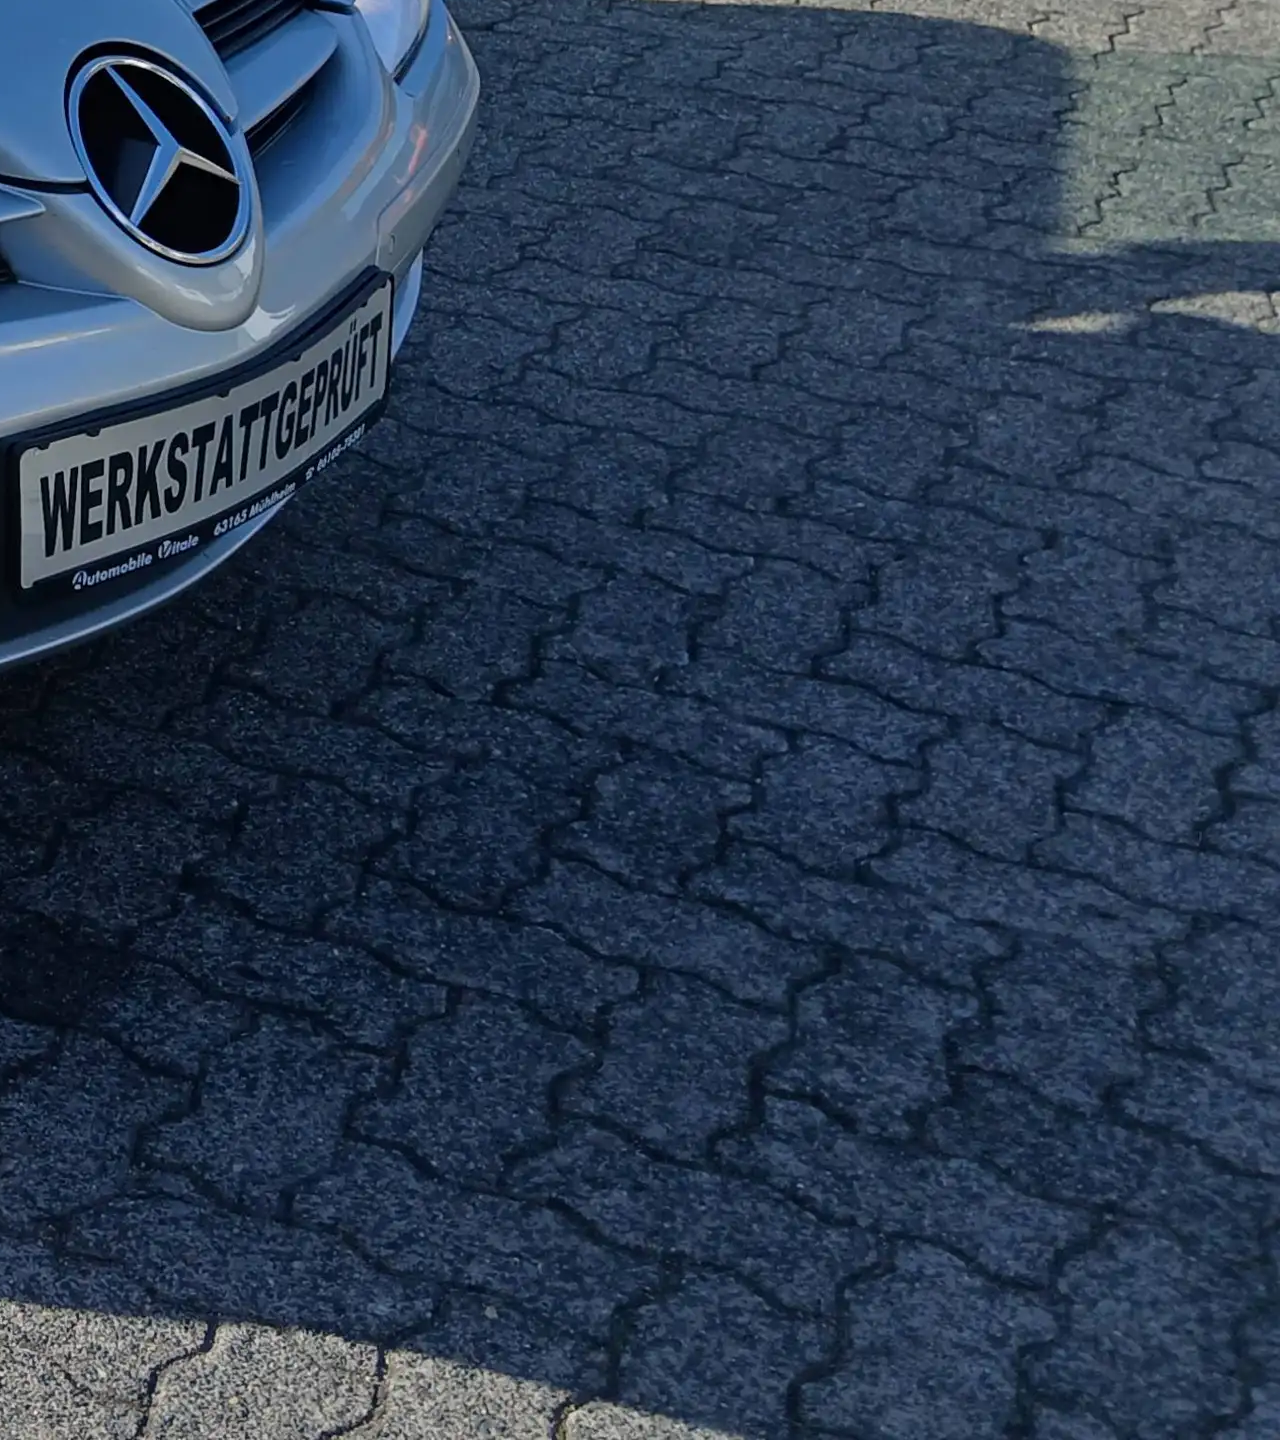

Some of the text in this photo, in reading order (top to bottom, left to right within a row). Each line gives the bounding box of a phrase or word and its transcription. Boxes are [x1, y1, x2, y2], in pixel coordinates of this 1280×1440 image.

[41, 312, 383, 557] WERKSTATTGEPRÜFT
[73, 551, 153, 590] Automobile
[158, 534, 199, 560] Vitale
[214, 510, 248, 536] 63165
[249, 481, 296, 518] Mühlheim
